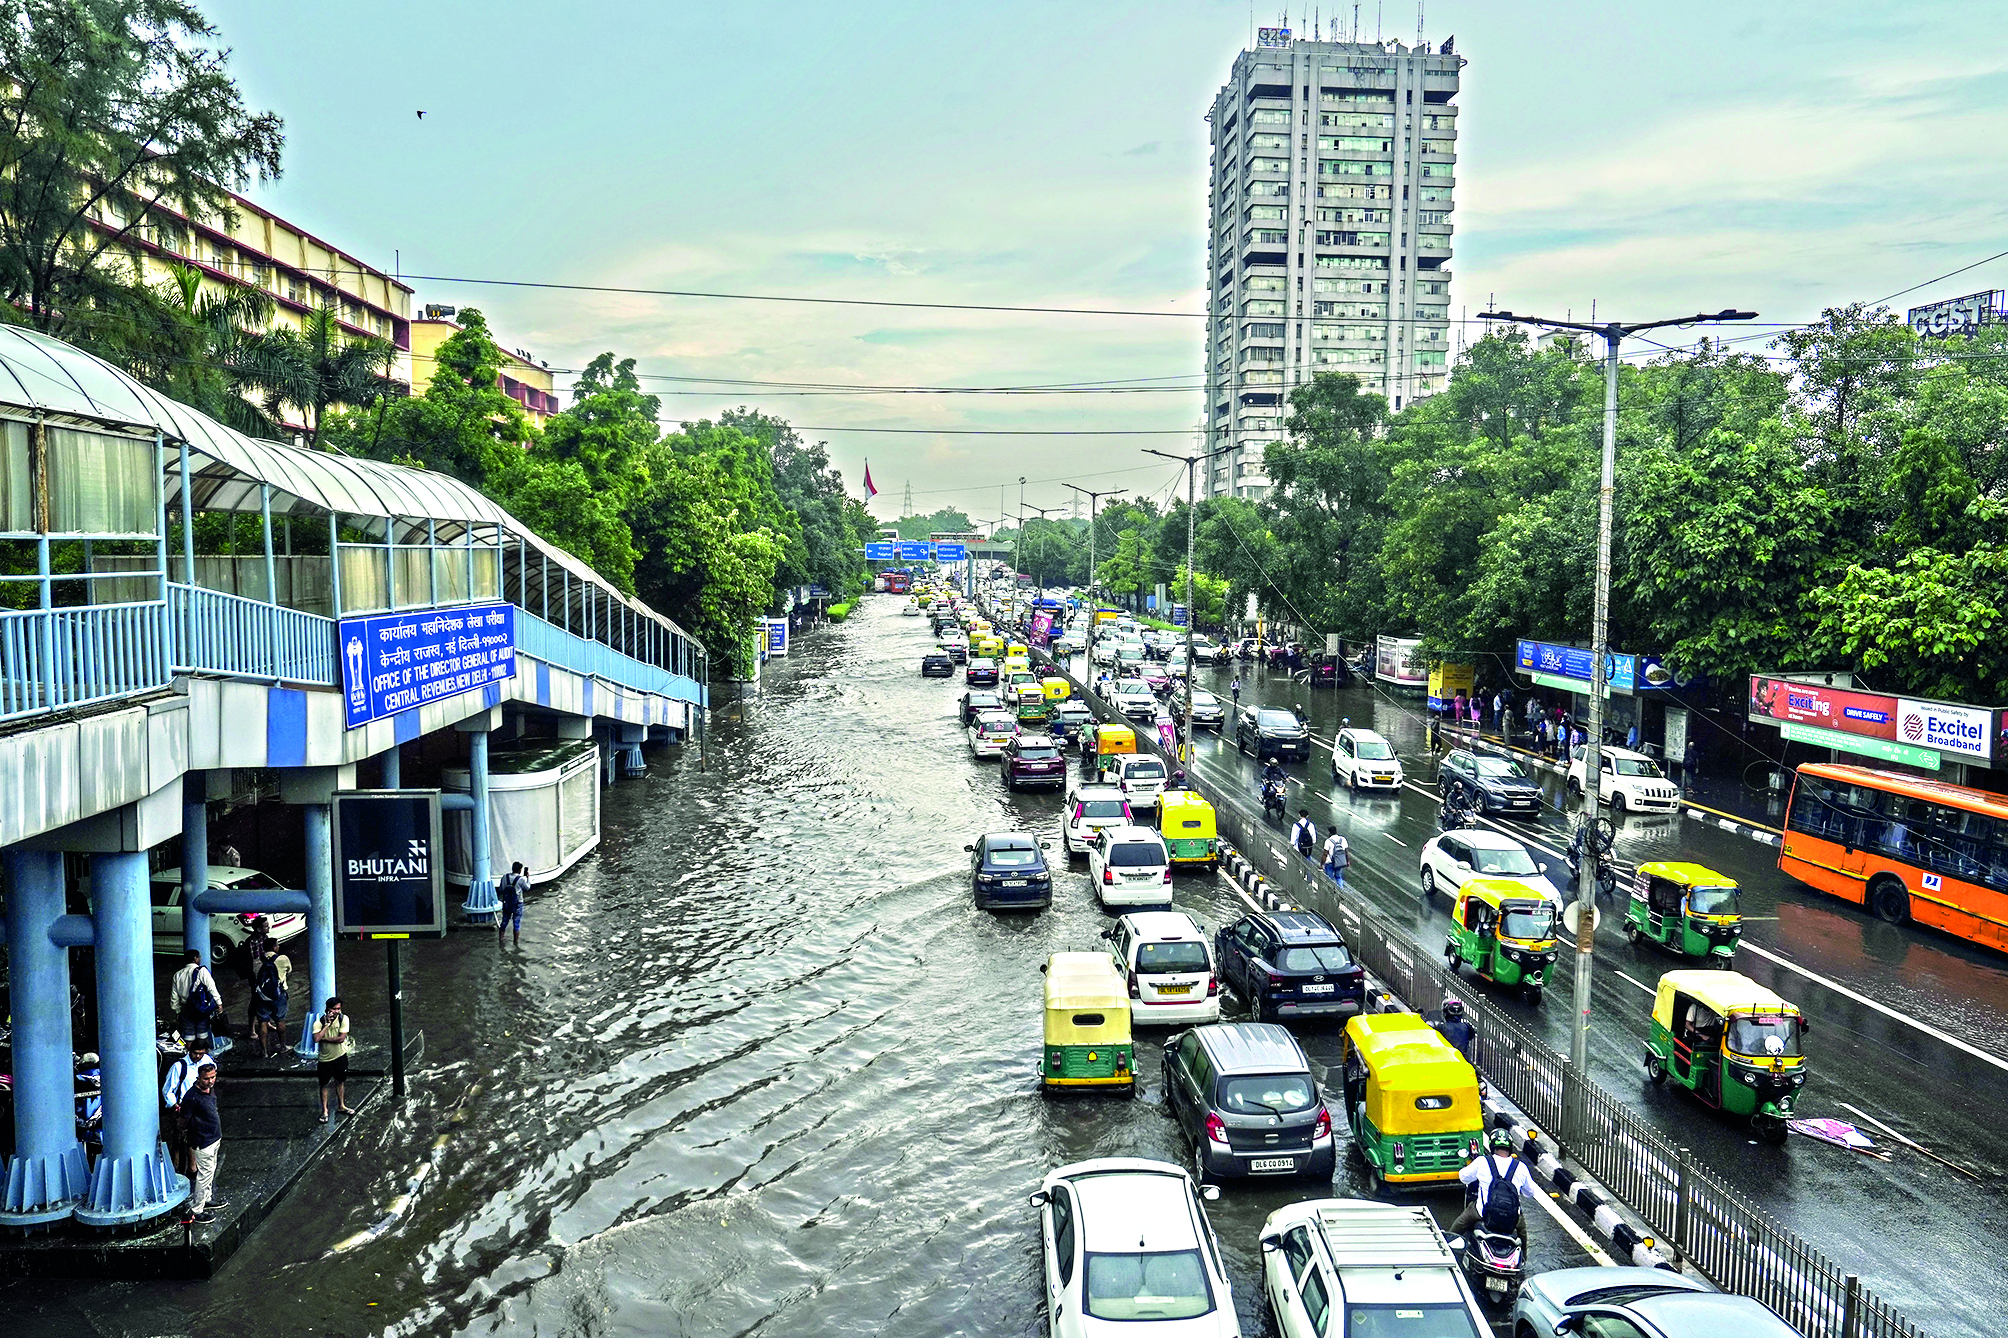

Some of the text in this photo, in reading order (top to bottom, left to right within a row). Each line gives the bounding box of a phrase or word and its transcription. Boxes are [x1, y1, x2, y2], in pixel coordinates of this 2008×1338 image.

[379, 610, 505, 642] कार्यालय महानिदेशक लेखा परीक्षा
[380, 646, 410, 667] केन्द्रीय
[445, 637, 456, 655] नई
[373, 646, 514, 693] OFFICE OF THE DIRECTOR GENERAL OF AUDIT
[385, 687, 420, 711] CENTRAL
[457, 673, 471, 689] NEW
[472, 668, 488, 686] DELHI
[1788, 694, 1830, 716] Exciting
[1846, 709, 1883, 721] DRIVE SAFELY
[1950, 709, 1963, 717] Safety
[1928, 716, 1983, 740] Excitel
[1927, 733, 1981, 752] Broadband
[348, 858, 428, 875] BHUTANI
